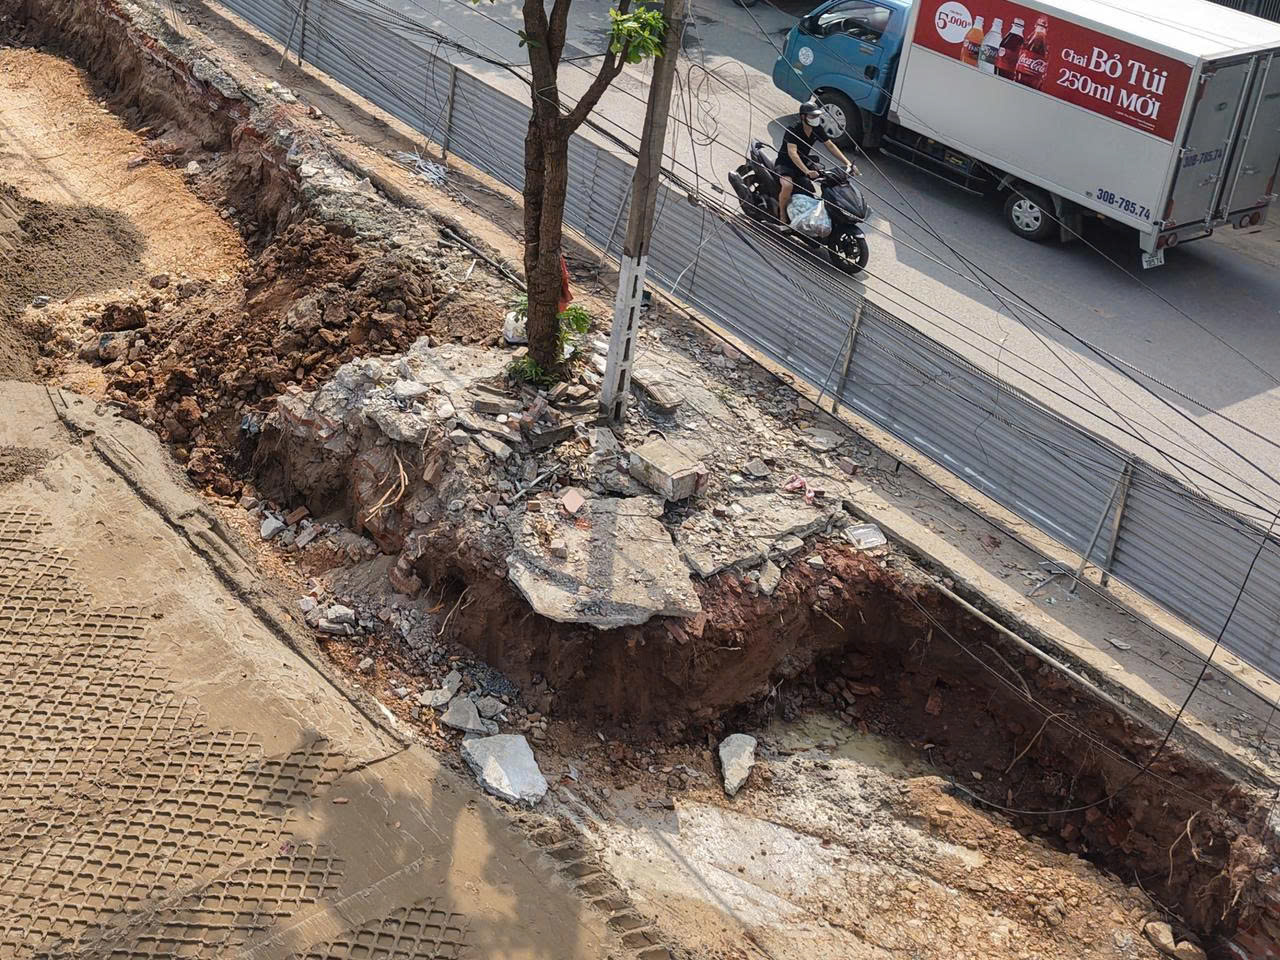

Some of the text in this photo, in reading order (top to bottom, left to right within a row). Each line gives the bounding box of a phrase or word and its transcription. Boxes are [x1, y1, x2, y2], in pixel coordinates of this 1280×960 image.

[1056, 67, 1161, 120] 250ml MỚI
[1061, 46, 1168, 96] Chai Bỏ Túi
[1096, 188, 1151, 220] 30B-785.74
